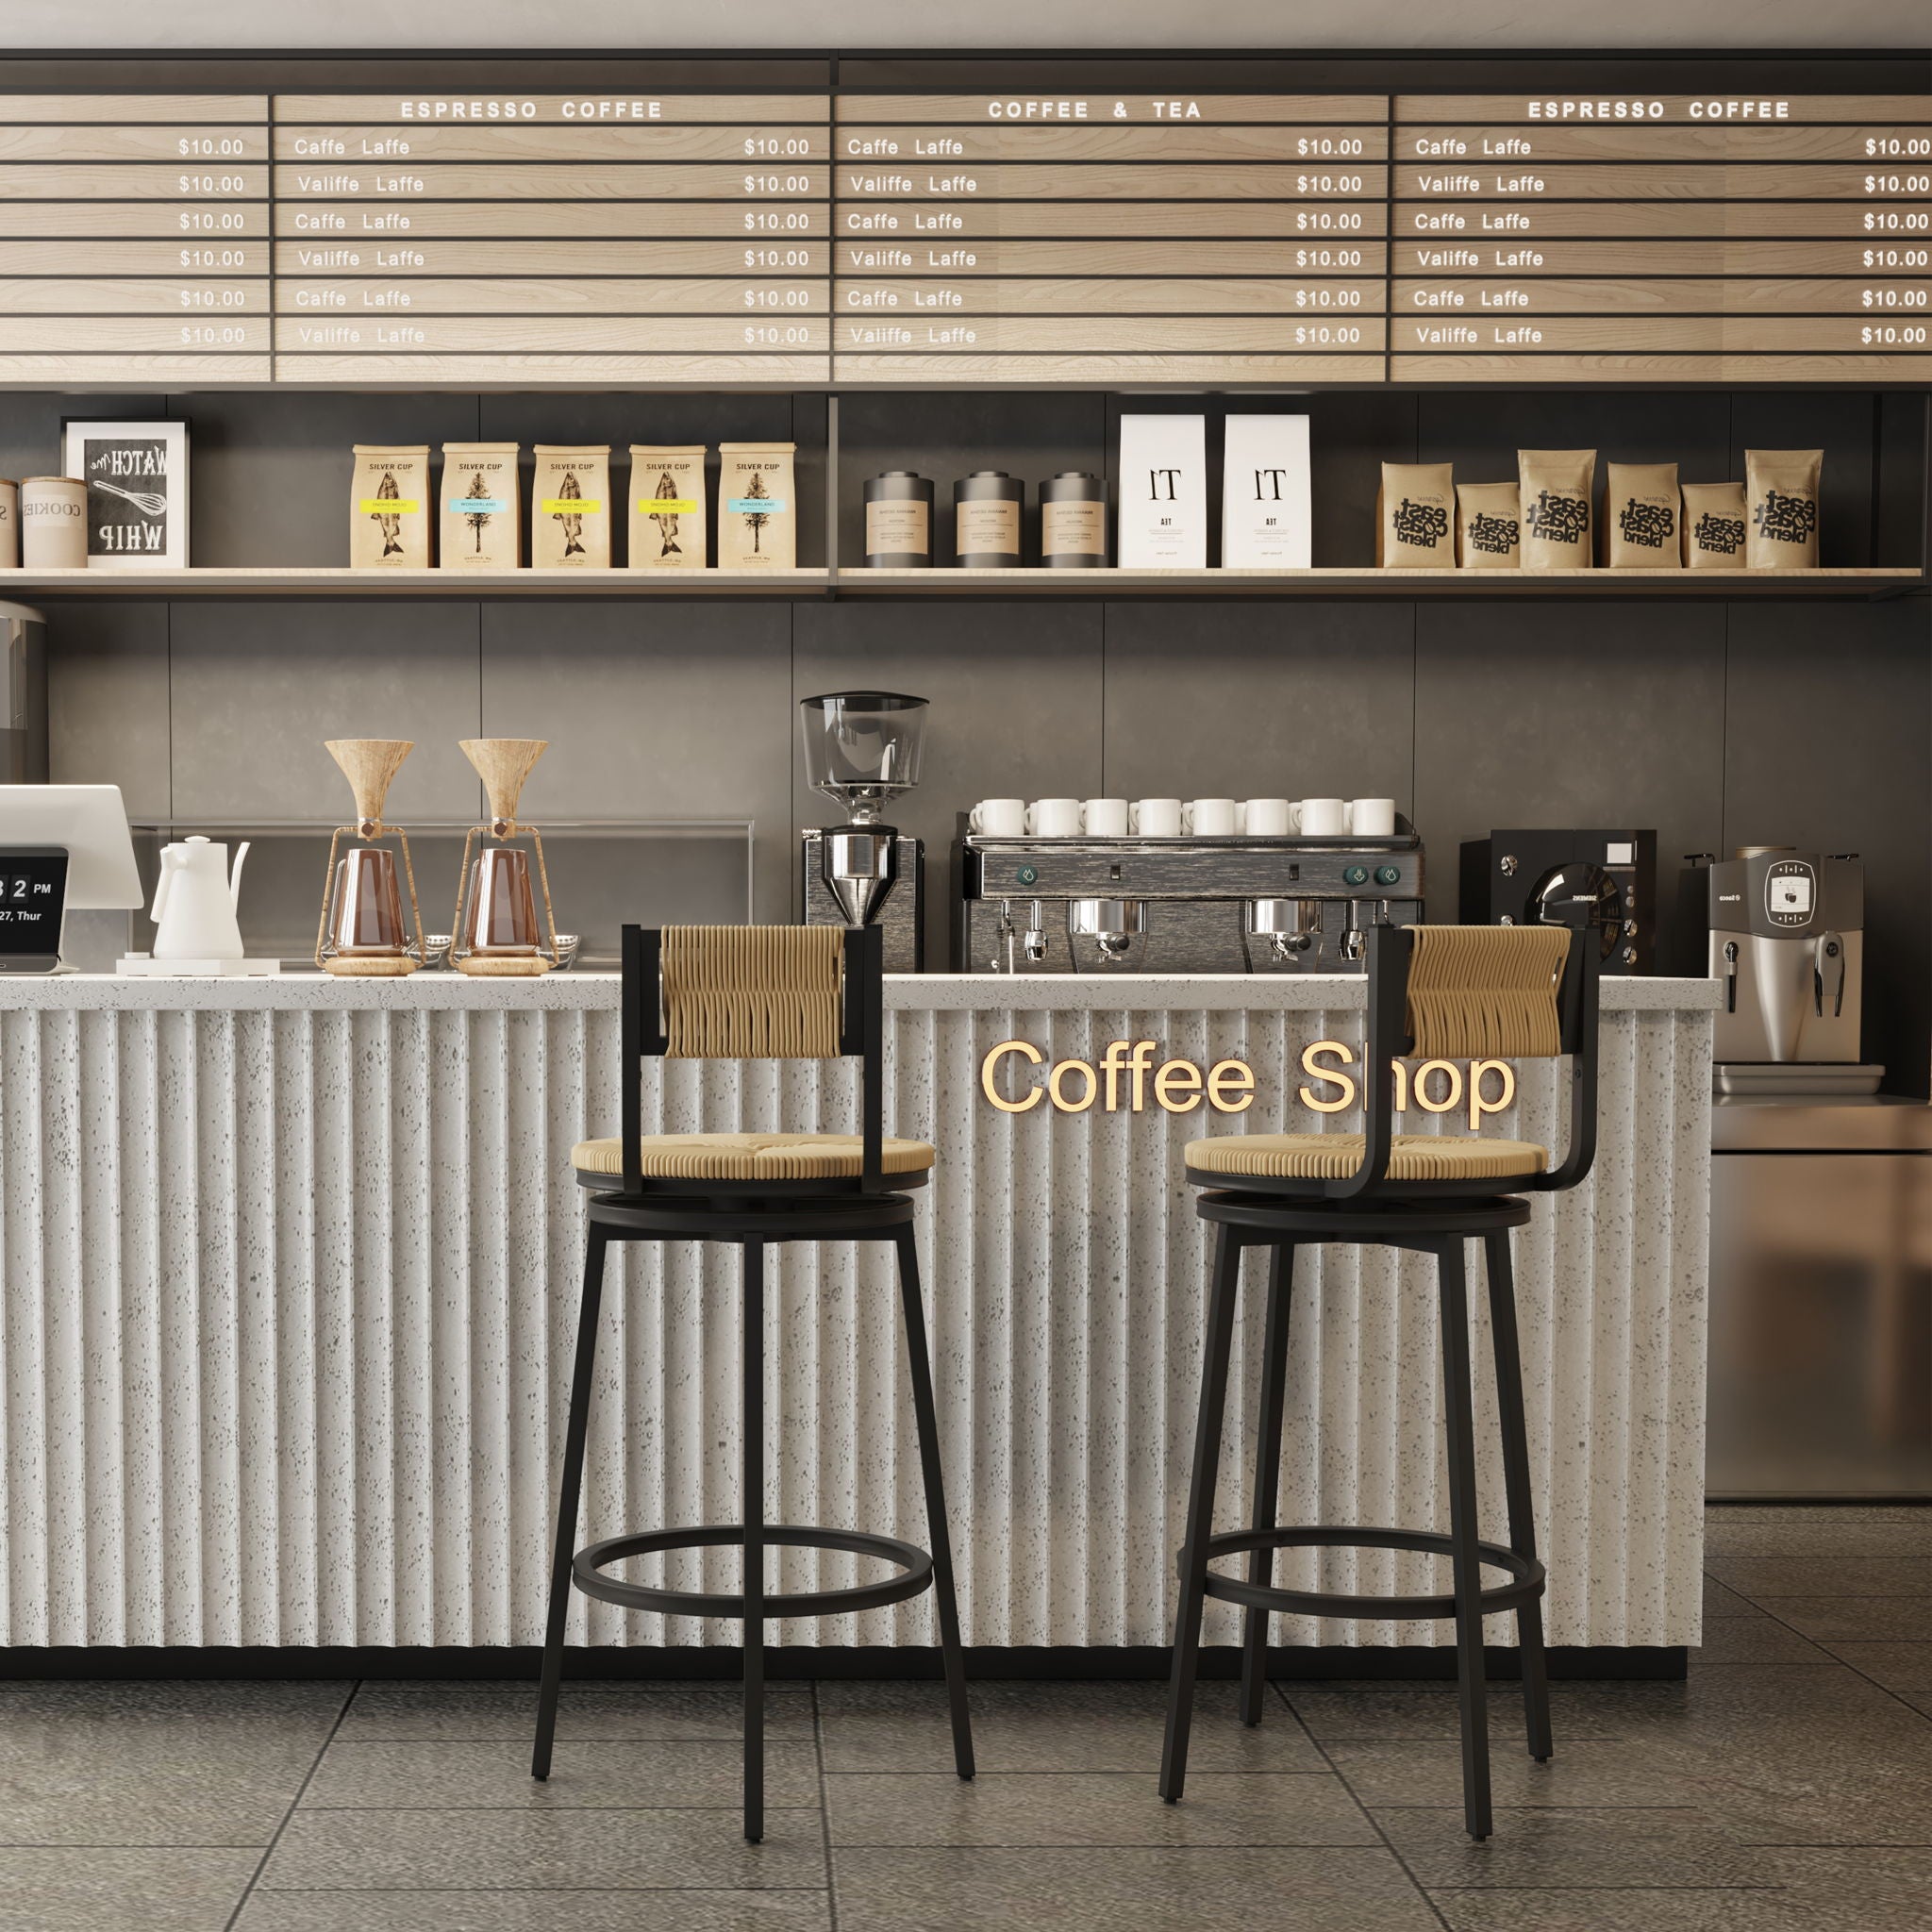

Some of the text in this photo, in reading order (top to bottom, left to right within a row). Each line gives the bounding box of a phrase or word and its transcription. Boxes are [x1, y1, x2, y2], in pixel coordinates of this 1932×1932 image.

[402, 102, 660, 118] ESPRESSO COFFEE
[989, 102, 1200, 118] COFFEE & TEA
[1529, 102, 1788, 118] ESPRESSO COFFEE
[179, 139, 242, 156] $10.00
[295, 139, 808, 157] Caffe Laffe $10.00
[848, 138, 1361, 156] Caffe Laffe $10.00
[1416, 139, 1930, 156] Caffe Laffe $10.00
[180, 175, 243, 192] $10.00
[296, 175, 808, 193] Valiffe Laffe $10.00
[851, 175, 1361, 193] Valiffe Laffe $10.00
[1419, 175, 1929, 193] Valiffe Laffe $10.00
[180, 212, 243, 230] $10.00
[294, 213, 808, 230] Caffe Laffe $10.00
[847, 213, 1361, 230] Caffe Laffe $10.00
[1415, 212, 1928, 230] Caffe Laffe $10.00
[180, 250, 244, 267] $10.00
[298, 250, 808, 267] Valiffe Laffe $10.00
[850, 250, 1360, 267] Valiffe Laffe $10.00
[1418, 250, 1927, 267] Valiffe Laffe $10.00
[181, 290, 245, 306] $10.00
[296, 290, 808, 308] Caffe Laffe $10.00
[847, 290, 1360, 308] Caffe Laffe $10.00
[1414, 290, 1926, 308] Caffe Laffe $10.00
[181, 327, 245, 343] $10.00
[298, 325, 809, 343] Valiffe Laffe $10.00
[850, 326, 1359, 344] Valiffe Laffe $10.00
[1416, 326, 1925, 344] Valiffe Laffe $10.00
[34, 884, 51, 893] PM
[17, 911, 42, 921] Thur
[982, 1040, 1255, 1113] Coffee
